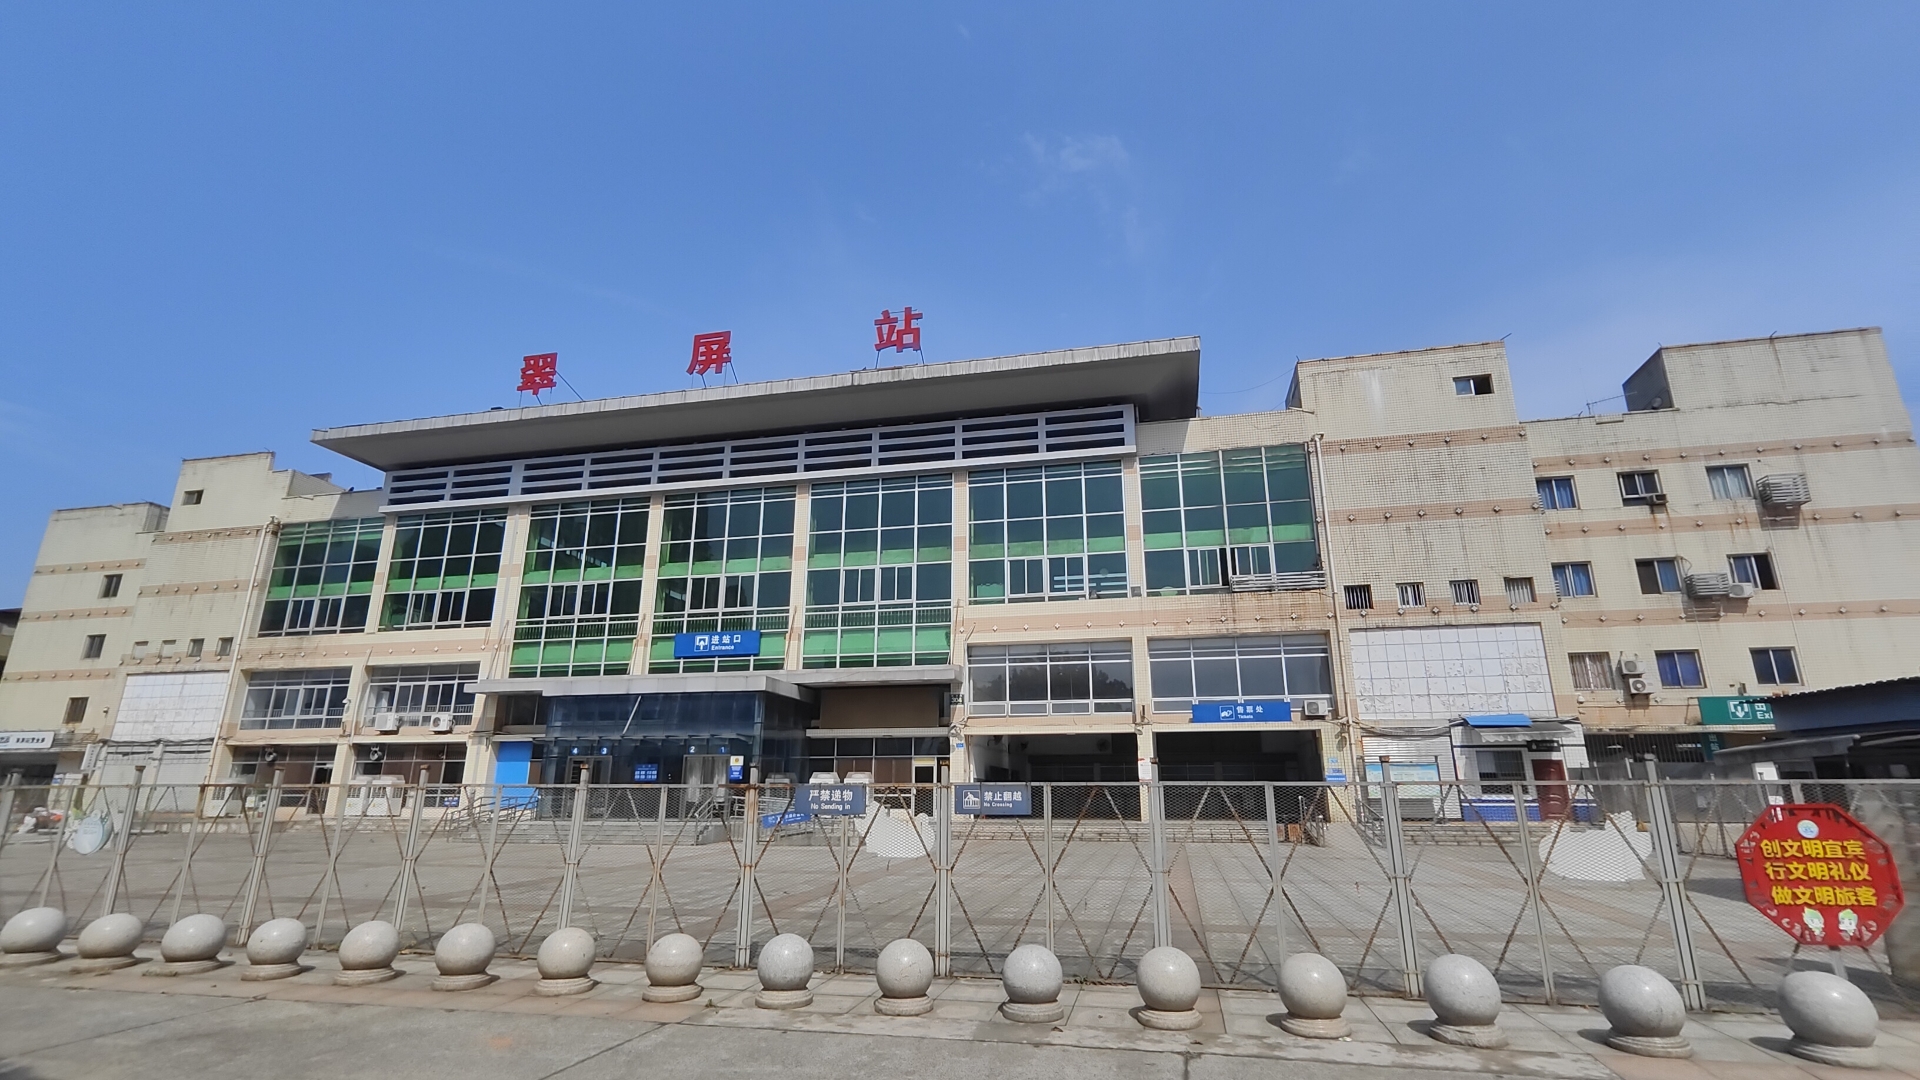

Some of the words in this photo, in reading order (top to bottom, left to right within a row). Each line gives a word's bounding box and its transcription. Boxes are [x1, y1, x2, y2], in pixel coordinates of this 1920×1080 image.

[517, 306, 923, 395] 翠屏站
[711, 634, 741, 644] 进站口
[1236, 705, 1264, 714] 售票处
[809, 789, 853, 801] 严禁递物
[984, 791, 1022, 801] 禁止翻越
[821, 803, 842, 811] Sending
[1760, 839, 1866, 860] 创文明宜宾
[1763, 861, 1872, 881] 行文明礼仪
[1771, 885, 1878, 906] 做文明旅客
